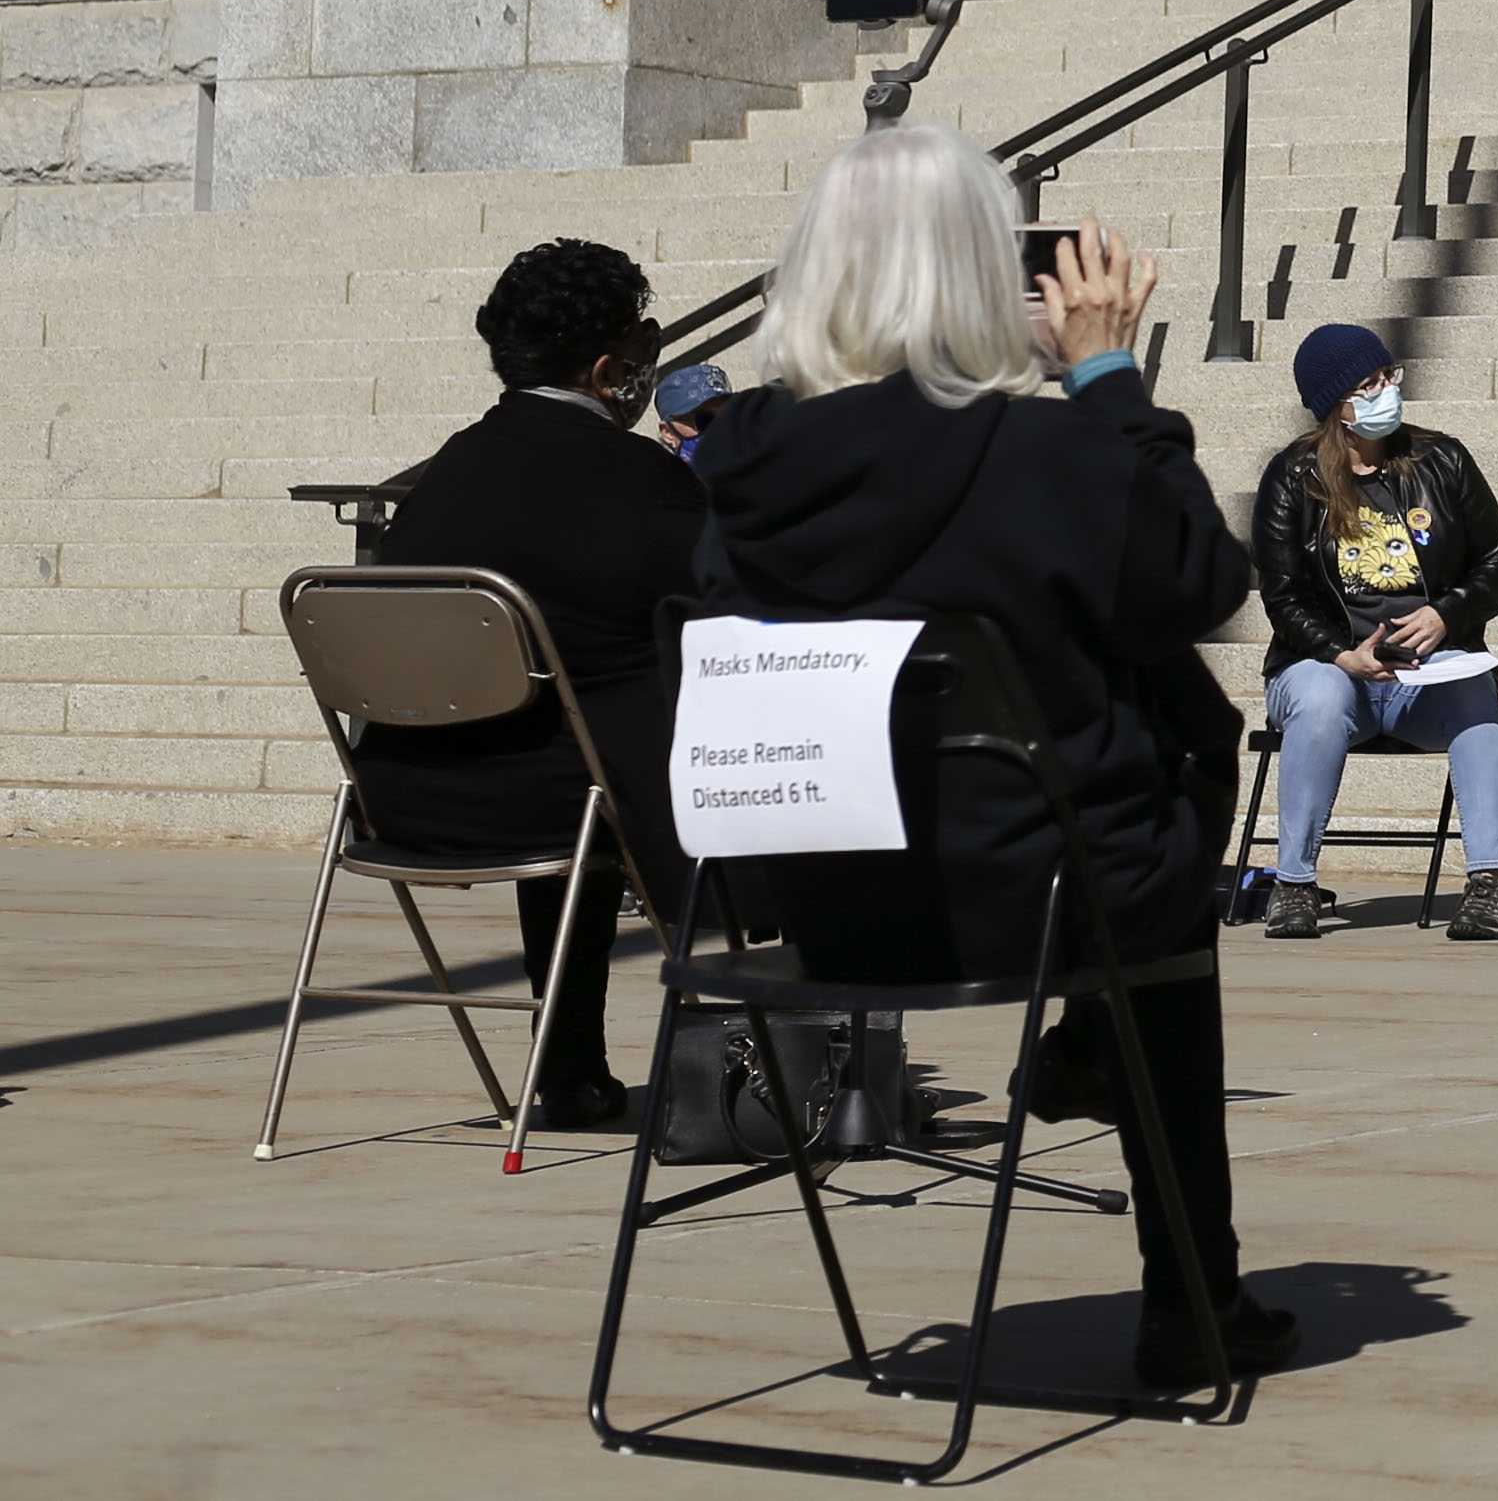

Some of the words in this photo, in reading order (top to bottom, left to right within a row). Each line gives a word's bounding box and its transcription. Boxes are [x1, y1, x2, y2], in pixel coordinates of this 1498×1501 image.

[699, 654, 751, 678] Masks
[755, 649, 869, 673] Mandatory.
[690, 744, 749, 768] Please
[753, 739, 824, 764] Remain
[692, 782, 785, 810] Distanced
[788, 782, 801, 805] 6
[804, 779, 827, 804] ft.
